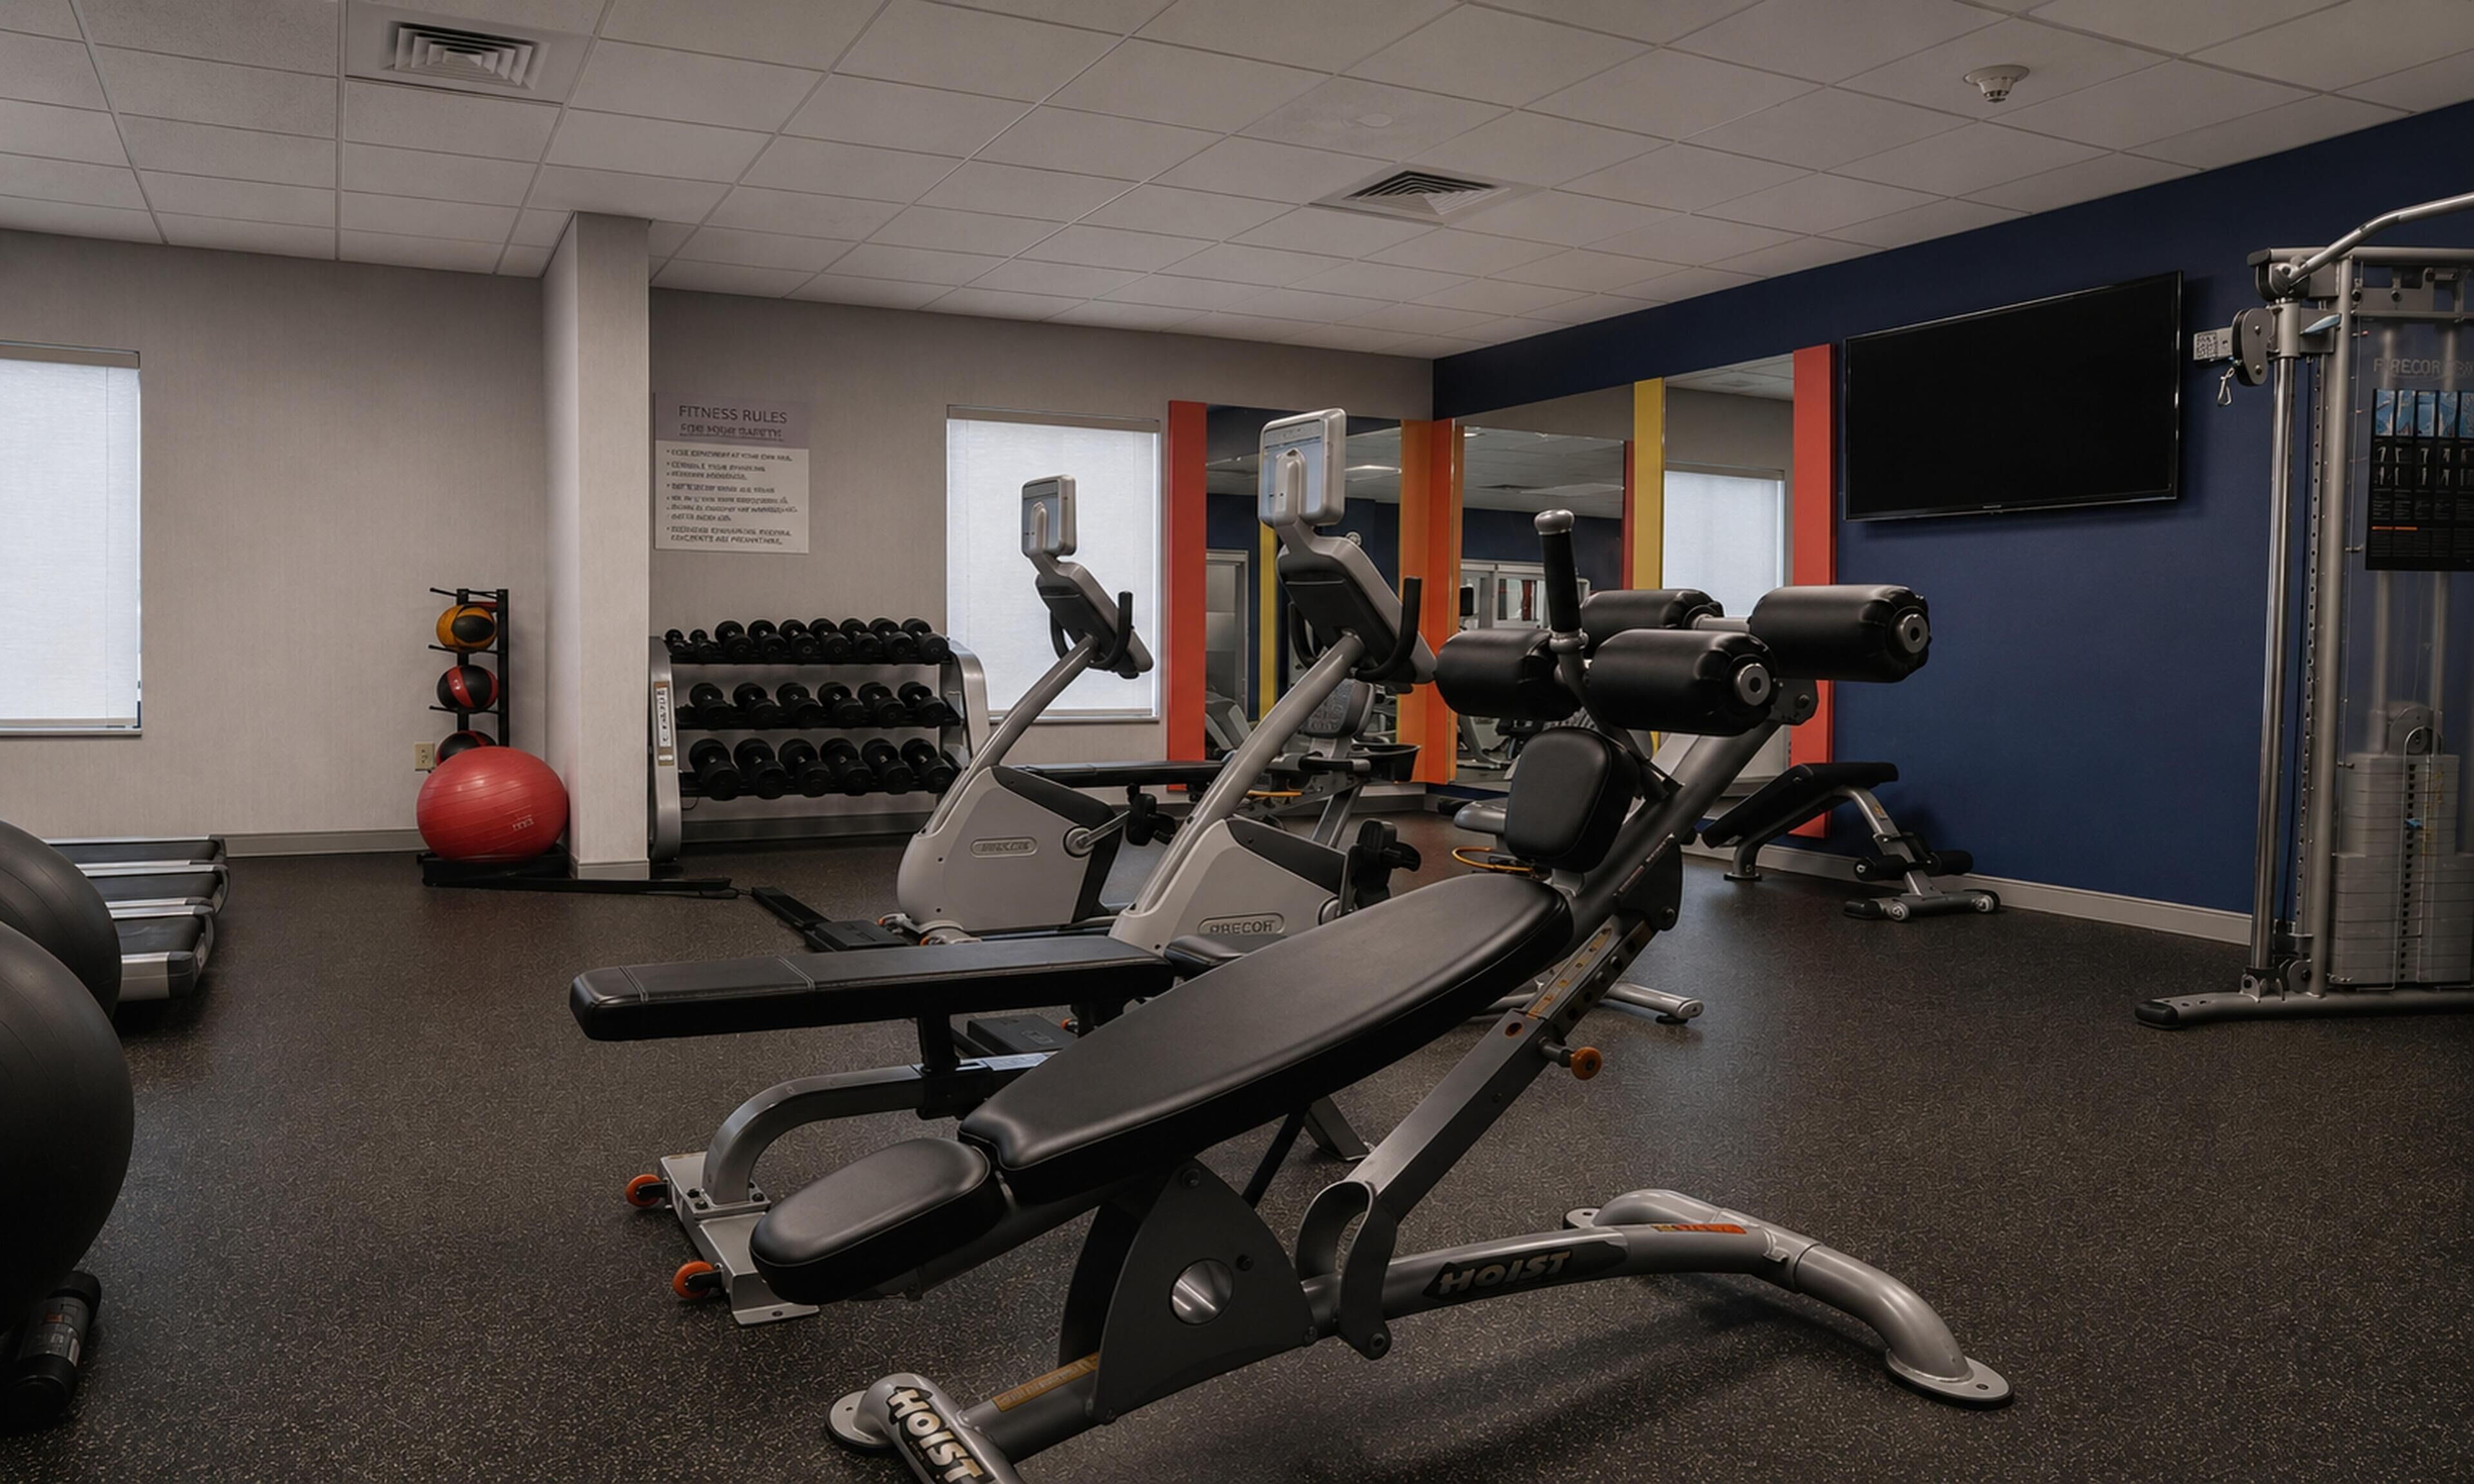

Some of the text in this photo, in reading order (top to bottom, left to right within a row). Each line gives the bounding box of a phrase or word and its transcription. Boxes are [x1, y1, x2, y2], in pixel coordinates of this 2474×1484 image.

[678, 405, 788, 424] FITNESS RULES
[1439, 1250, 1571, 1295] HOIST
[888, 1388, 985, 1483] HOIST
